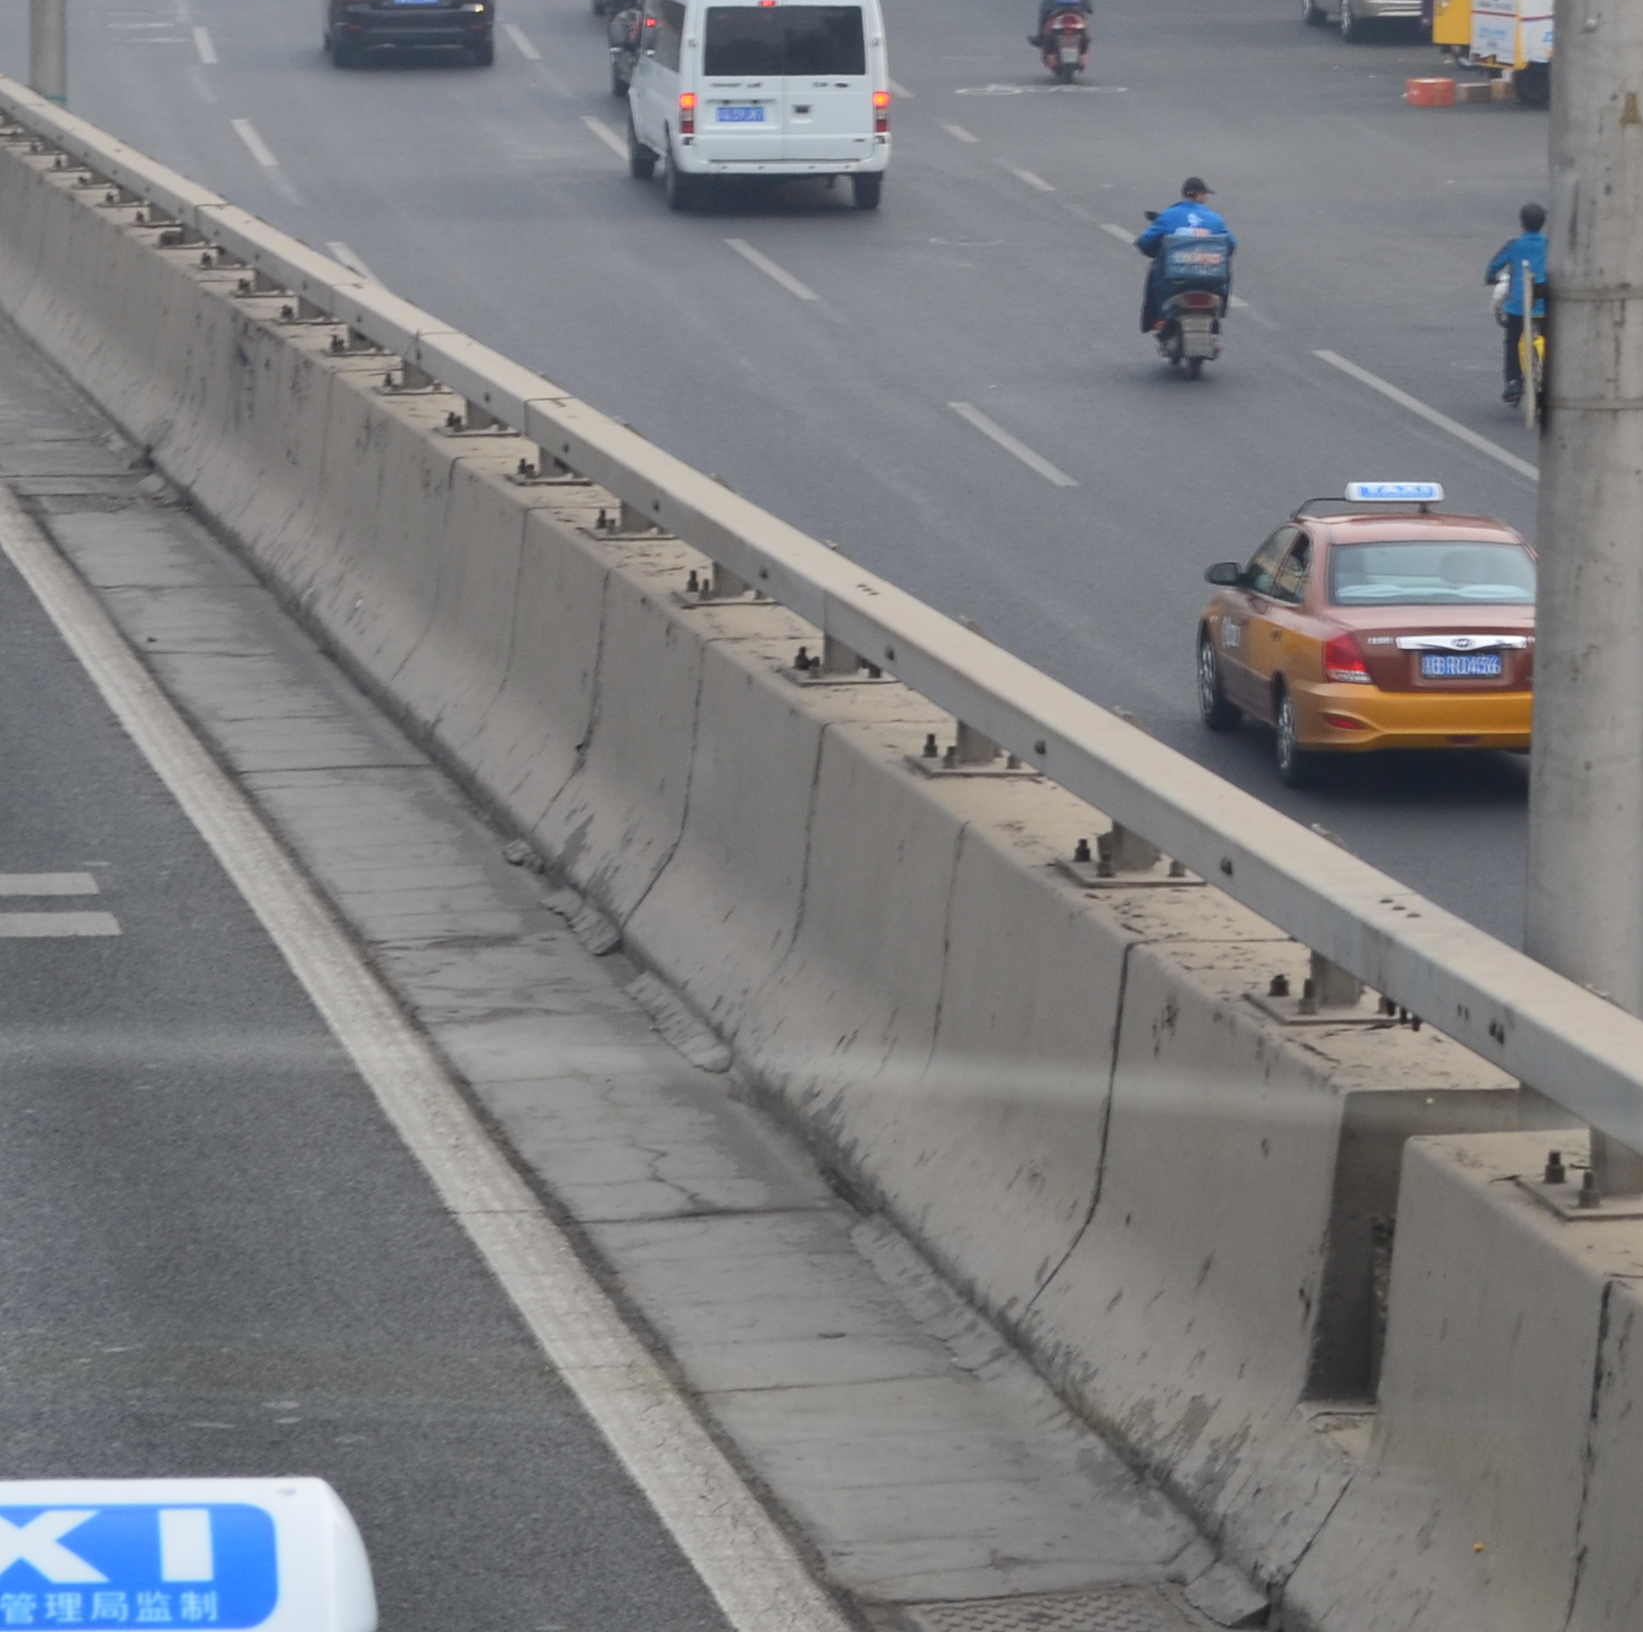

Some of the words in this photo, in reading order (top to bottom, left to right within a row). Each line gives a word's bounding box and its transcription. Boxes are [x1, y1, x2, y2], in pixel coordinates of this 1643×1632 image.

[1366, 483, 1431, 495] TAXI
[0, 1591, 219, 1624] 管理局监制
